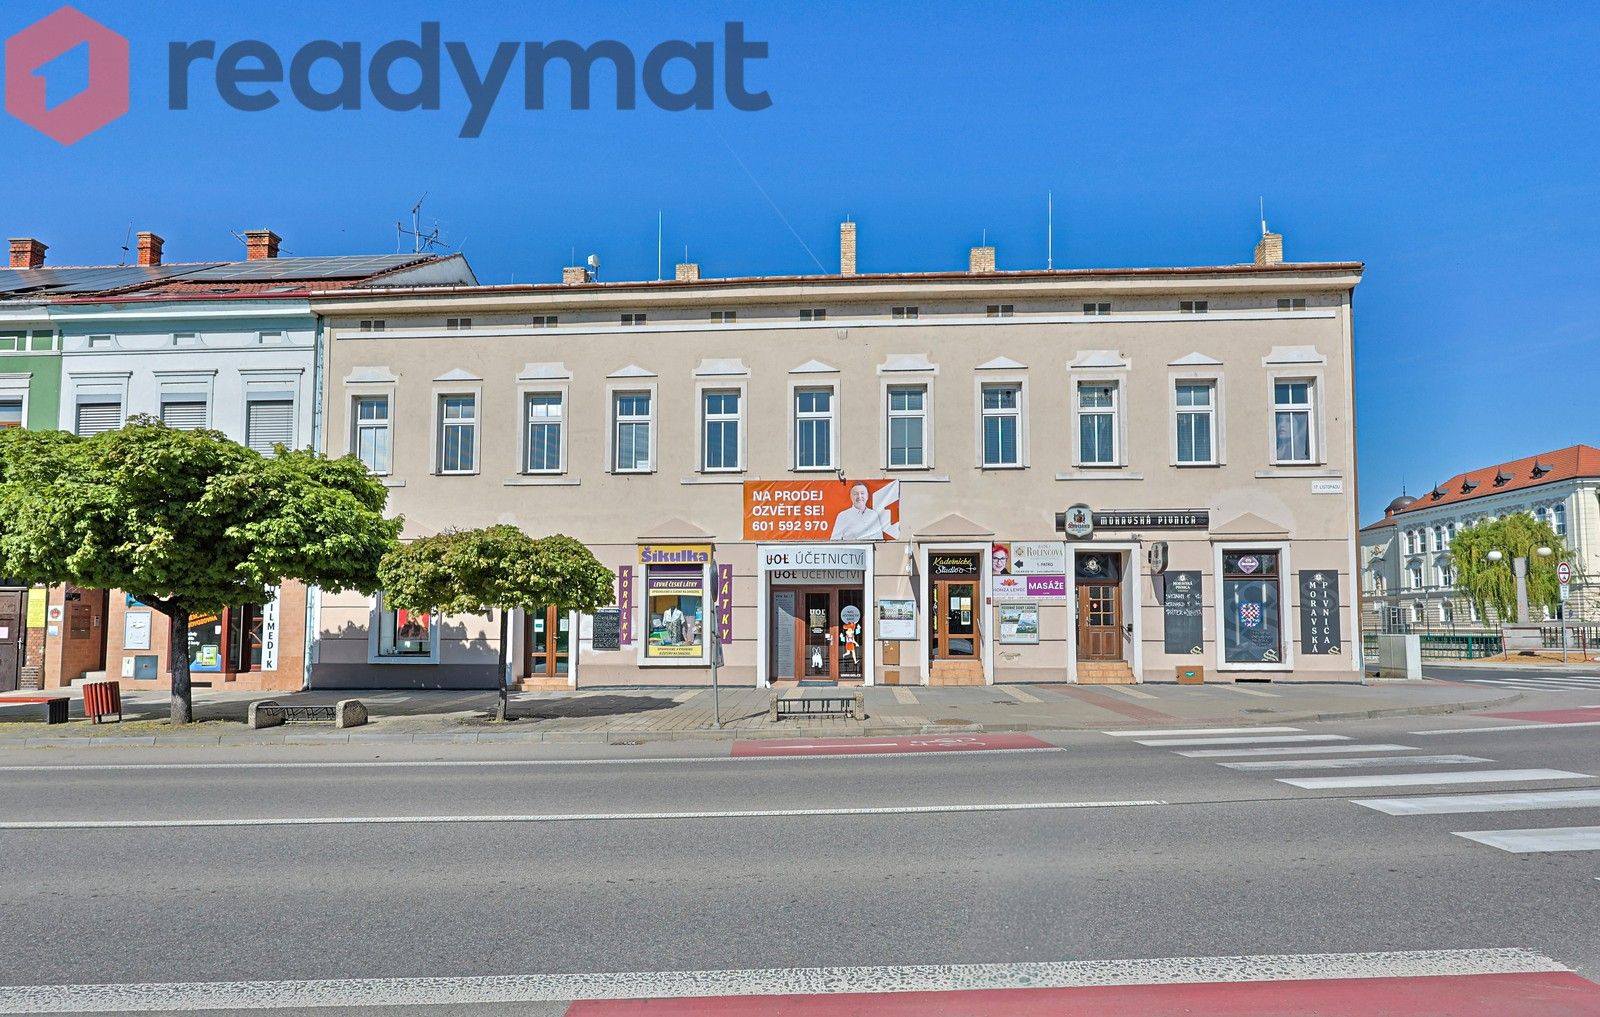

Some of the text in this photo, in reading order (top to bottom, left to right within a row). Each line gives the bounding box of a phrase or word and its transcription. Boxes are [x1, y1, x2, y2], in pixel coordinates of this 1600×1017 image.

[752, 491, 823, 501] NA PRODEJ
[752, 504, 825, 516] OZVĚTE SE!
[752, 521, 828, 531] 601 592 970
[1100, 515, 1196, 525] MORAVSKÁ PIVNICA
[641, 545, 708, 563] Šikulka
[795, 551, 864, 565] ÚČETNICTVÍ
[1028, 581, 1064, 590] MASÁŽE
[721, 568, 729, 640] LÁTKY
[1309, 582, 1319, 653] MORAVSKÁ
[1322, 582, 1331, 644] PIVNICA
